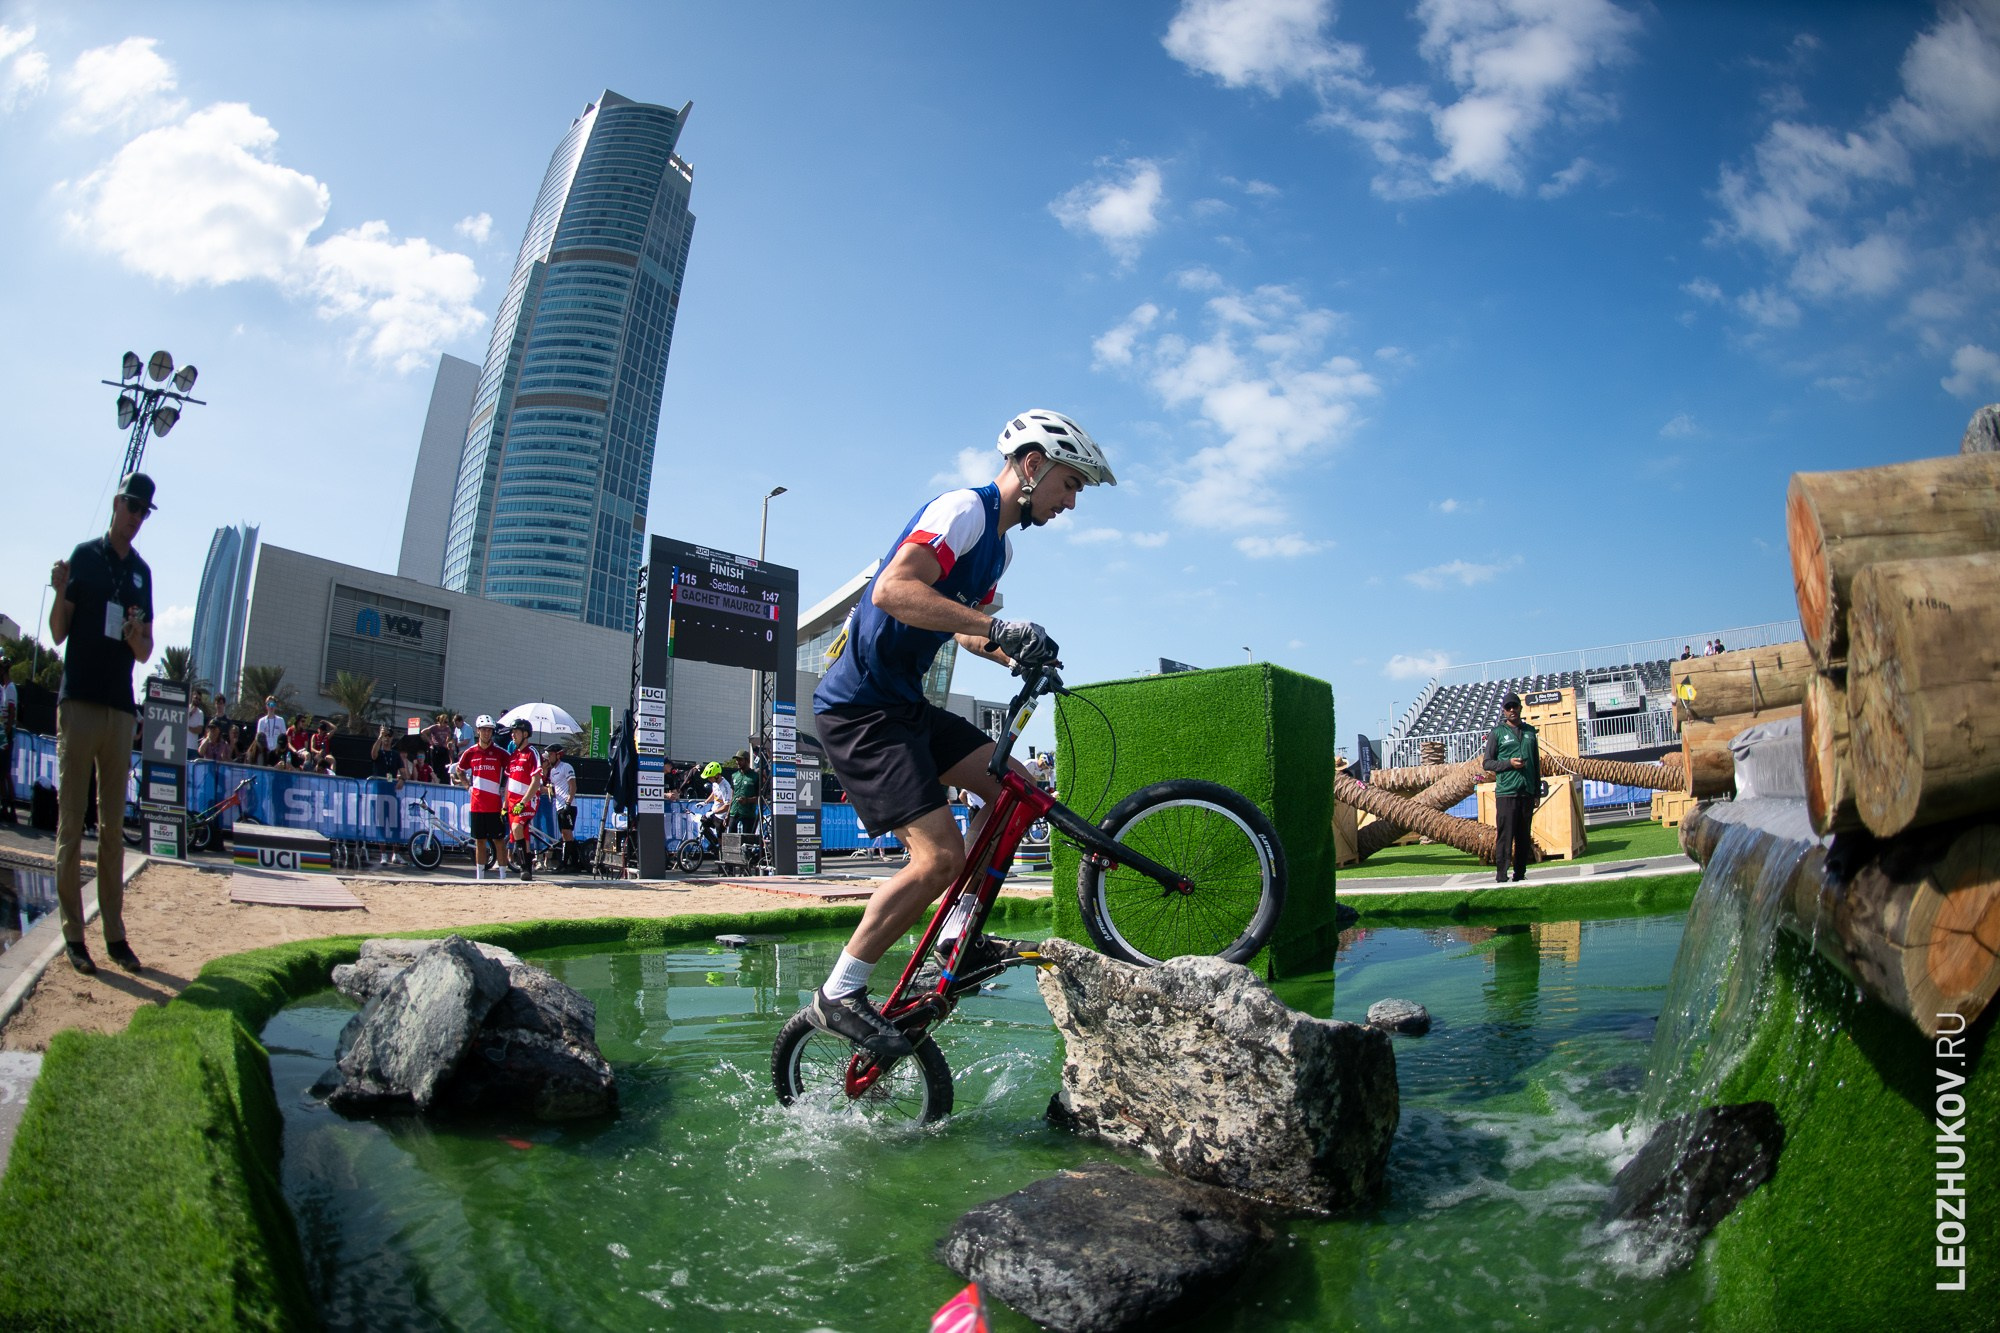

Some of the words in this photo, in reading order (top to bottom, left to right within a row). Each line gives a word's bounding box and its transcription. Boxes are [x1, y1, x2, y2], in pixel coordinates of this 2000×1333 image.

[709, 562, 744, 580] FINISH
[679, 572, 697, 586] 115
[681, 589, 720, 606] GACHET
[722, 597, 761, 614] MAUROZ
[761, 590, 780, 603] 1:47
[384, 613, 424, 640] VOX
[766, 629, 773, 642] 0
[645, 689, 664, 700] UCI
[147, 706, 185, 724] START
[154, 725, 175, 760] 4
[473, 764, 496, 772] AUSTRIA
[796, 770, 820, 781] INISH
[644, 787, 663, 798] UCI
[780, 792, 794, 801] UCI
[798, 782, 814, 807] 4
[153, 829, 174, 837] TISSOT
[259, 849, 298, 870] UCI
